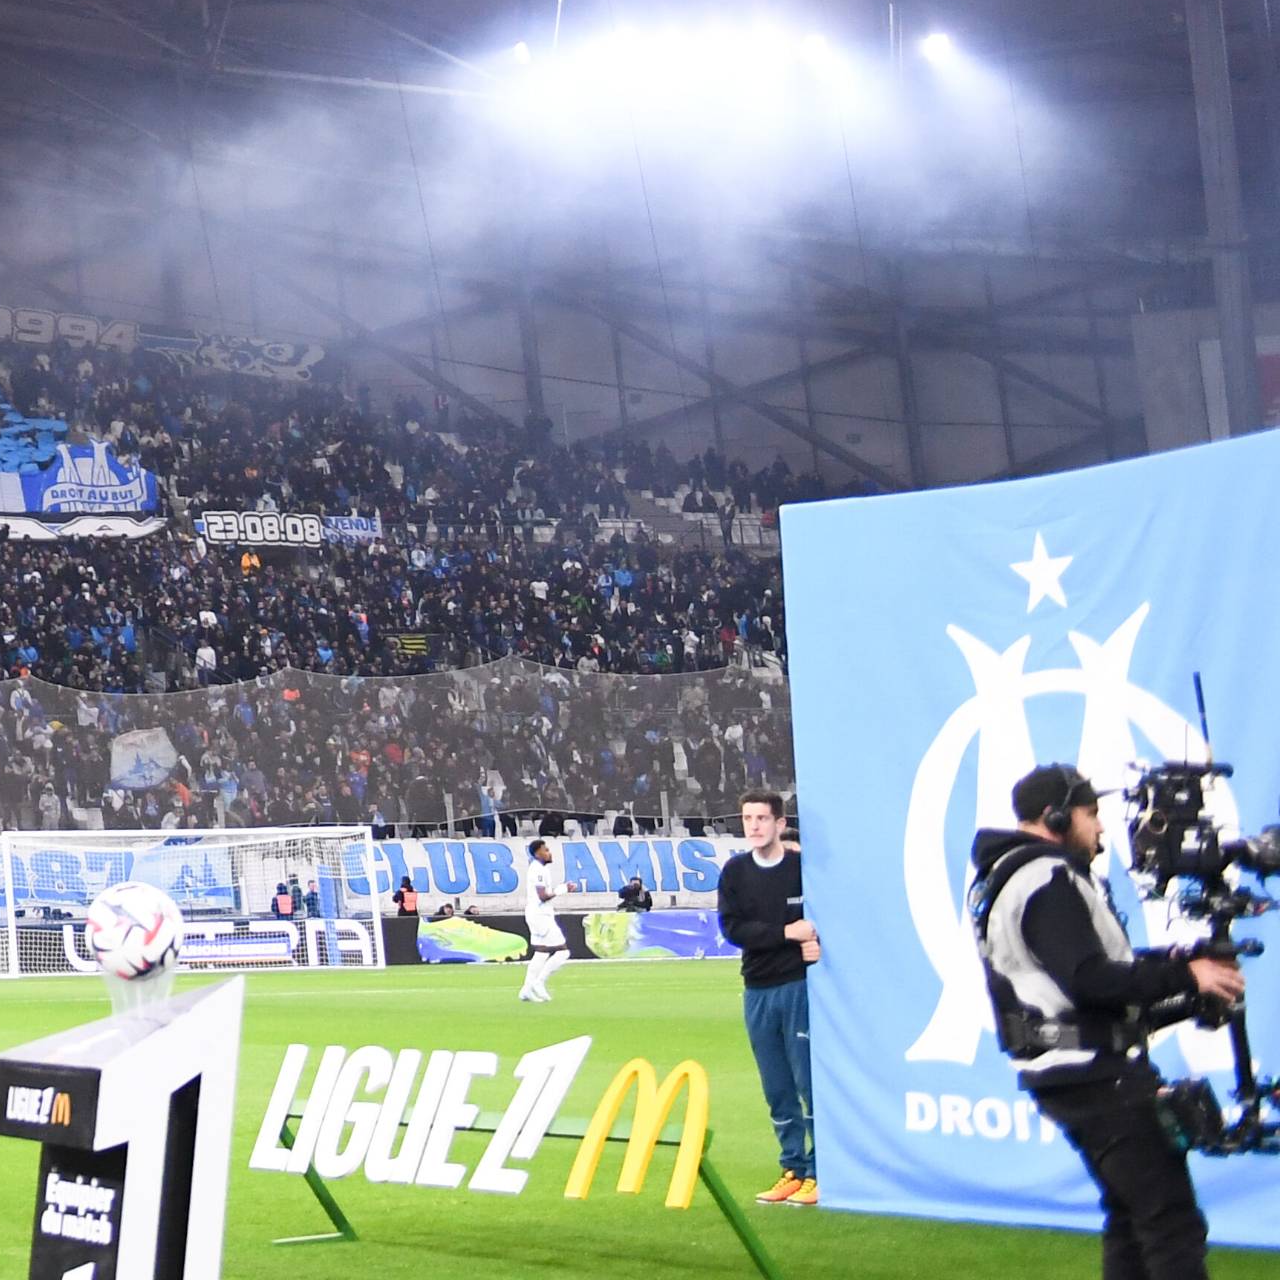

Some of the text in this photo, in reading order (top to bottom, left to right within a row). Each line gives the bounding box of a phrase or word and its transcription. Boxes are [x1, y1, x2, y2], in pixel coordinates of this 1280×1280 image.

[87, 489, 109, 500] AU
[111, 489, 134, 500] BUT
[204, 513, 322, 546] 23.08.08
[347, 838, 722, 896] CLUB AMIS
